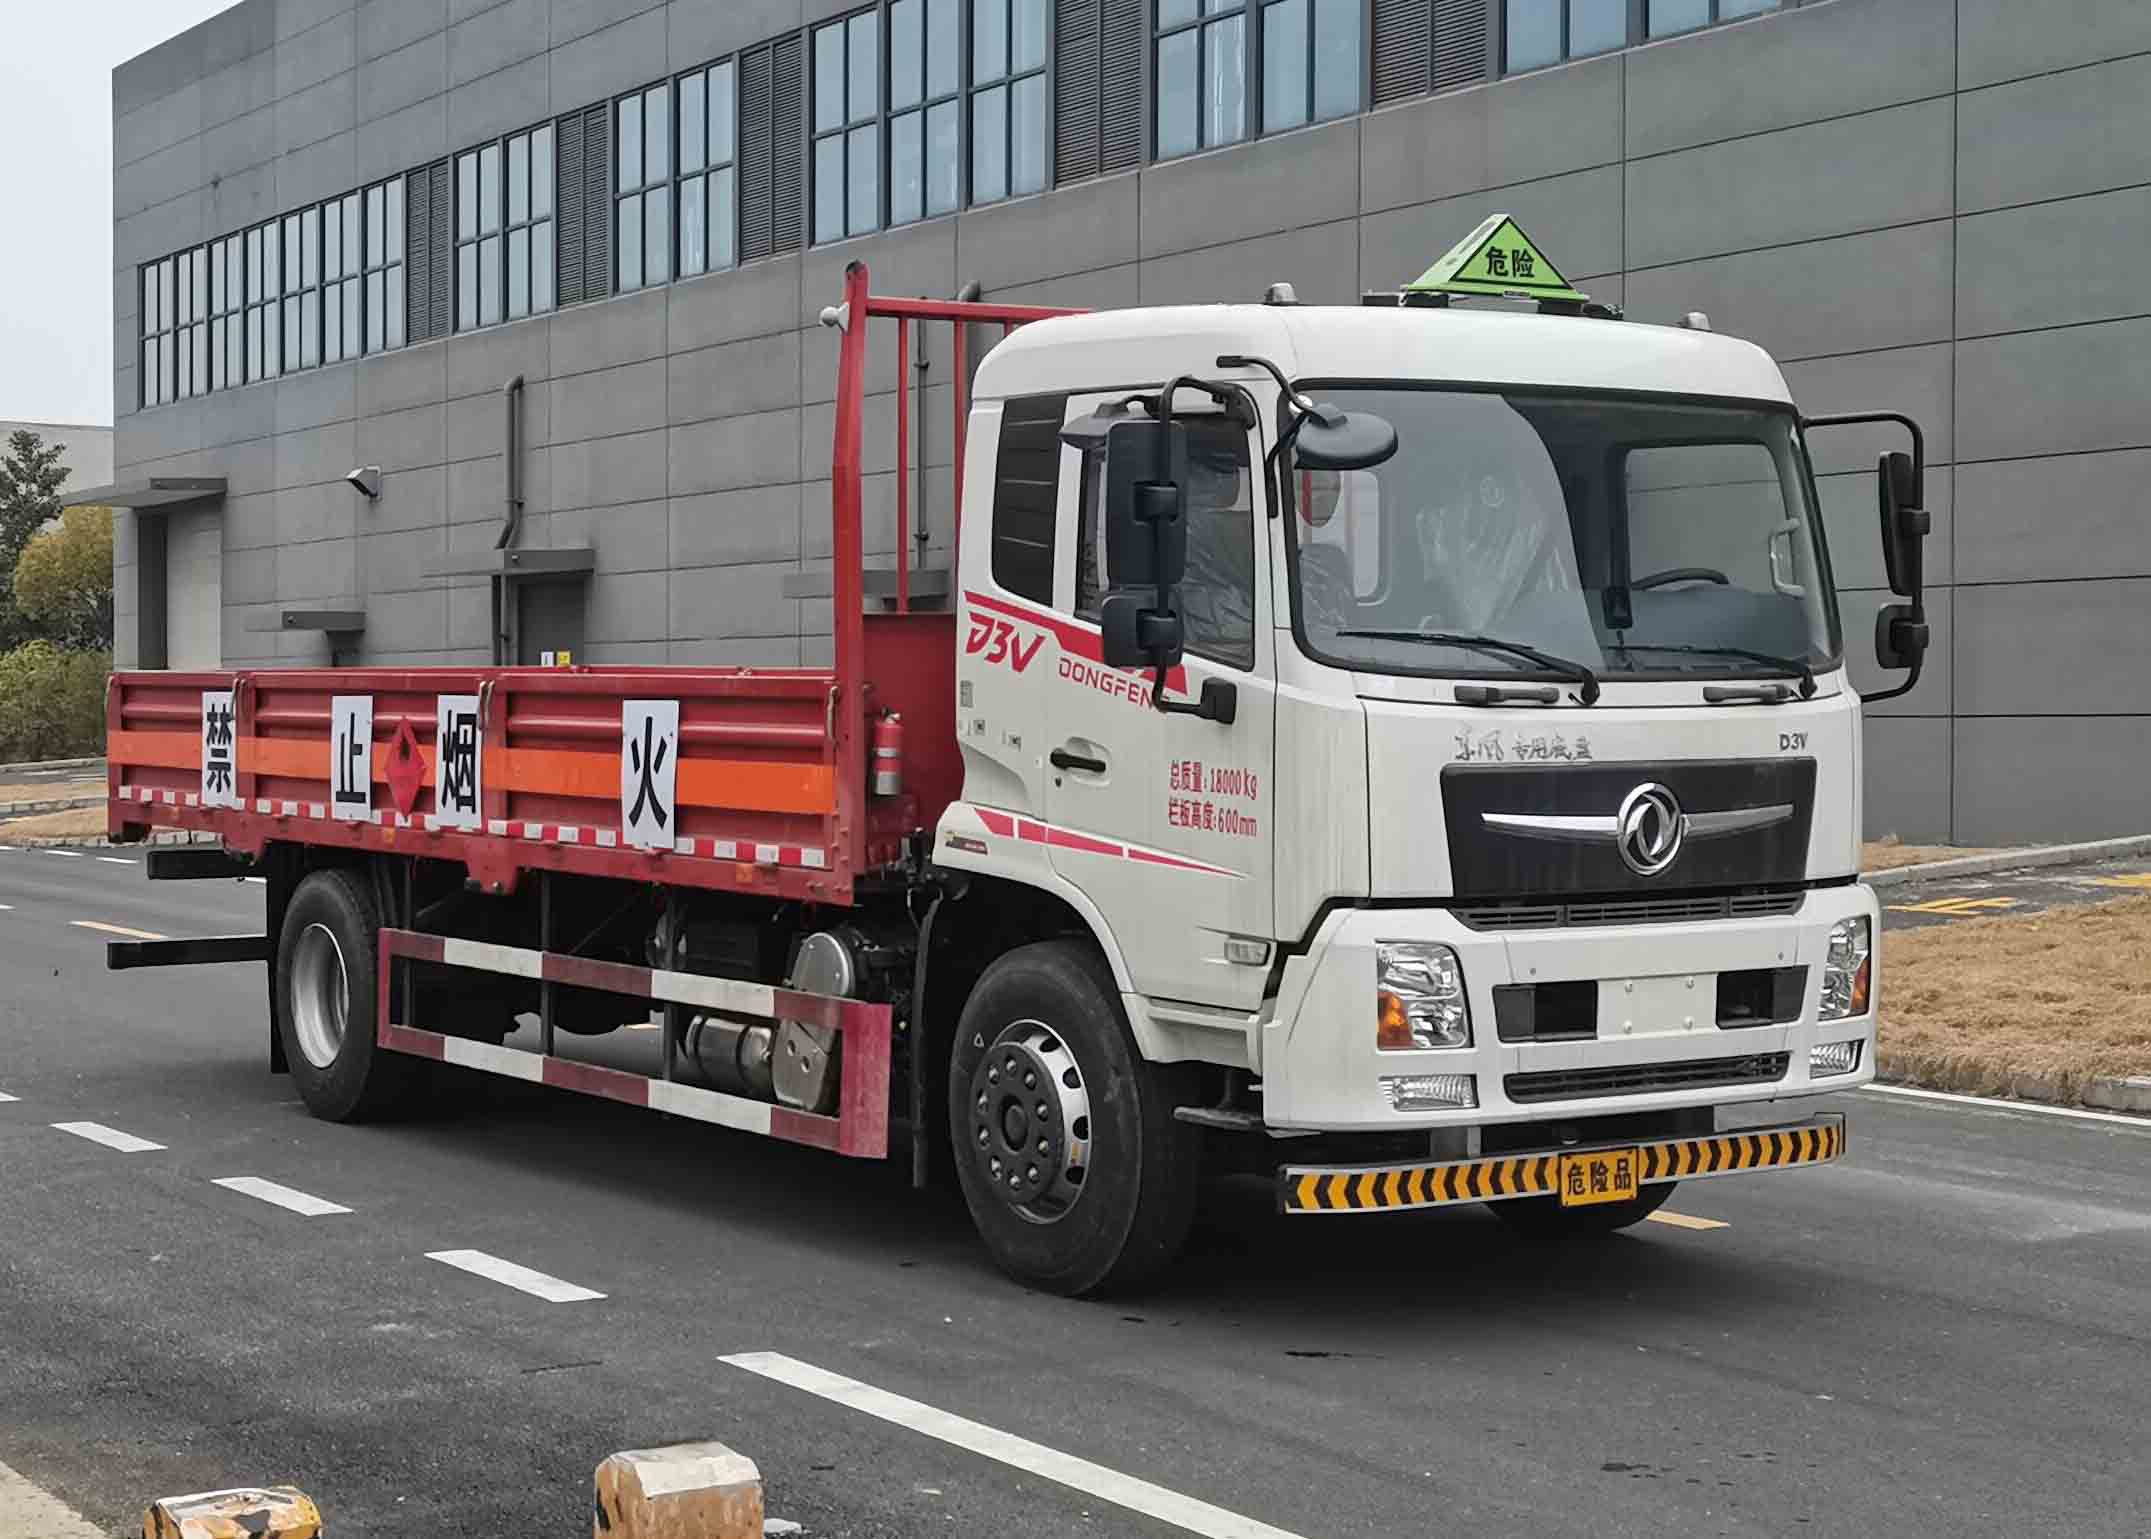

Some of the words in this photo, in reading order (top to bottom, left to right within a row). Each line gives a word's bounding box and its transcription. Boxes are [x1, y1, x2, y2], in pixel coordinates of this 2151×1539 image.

[1485, 246, 1535, 278] 危险
[1058, 657, 1171, 714] DONGFEN
[1780, 732, 1808, 751] D3V
[206, 704, 234, 792] 禁
[335, 712, 366, 803] 止
[442, 710, 477, 813] 烟
[628, 716, 667, 829] 火
[1568, 1159, 1631, 1195] 危险品
